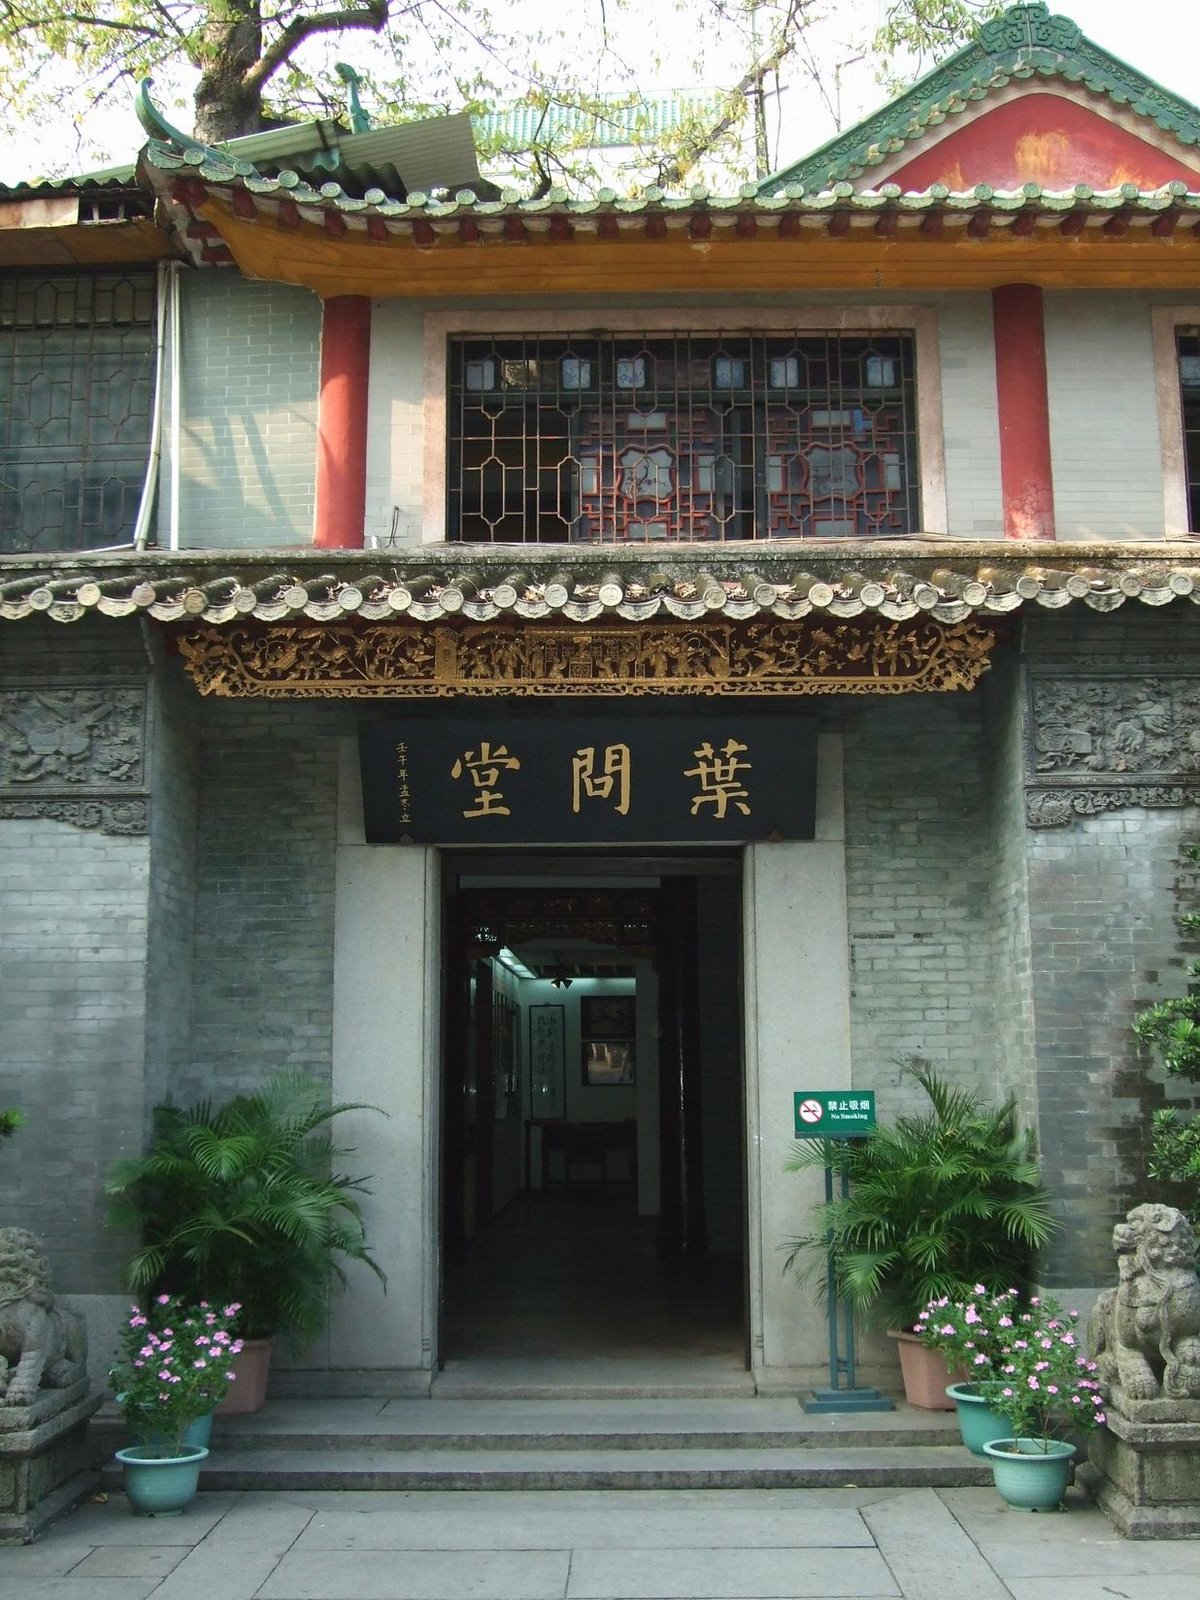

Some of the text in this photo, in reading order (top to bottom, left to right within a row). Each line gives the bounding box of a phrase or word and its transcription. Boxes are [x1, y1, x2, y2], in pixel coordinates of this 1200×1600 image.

[451, 739, 752, 819] 葉問堂
[827, 1100, 870, 1111] 禁止吸烟
